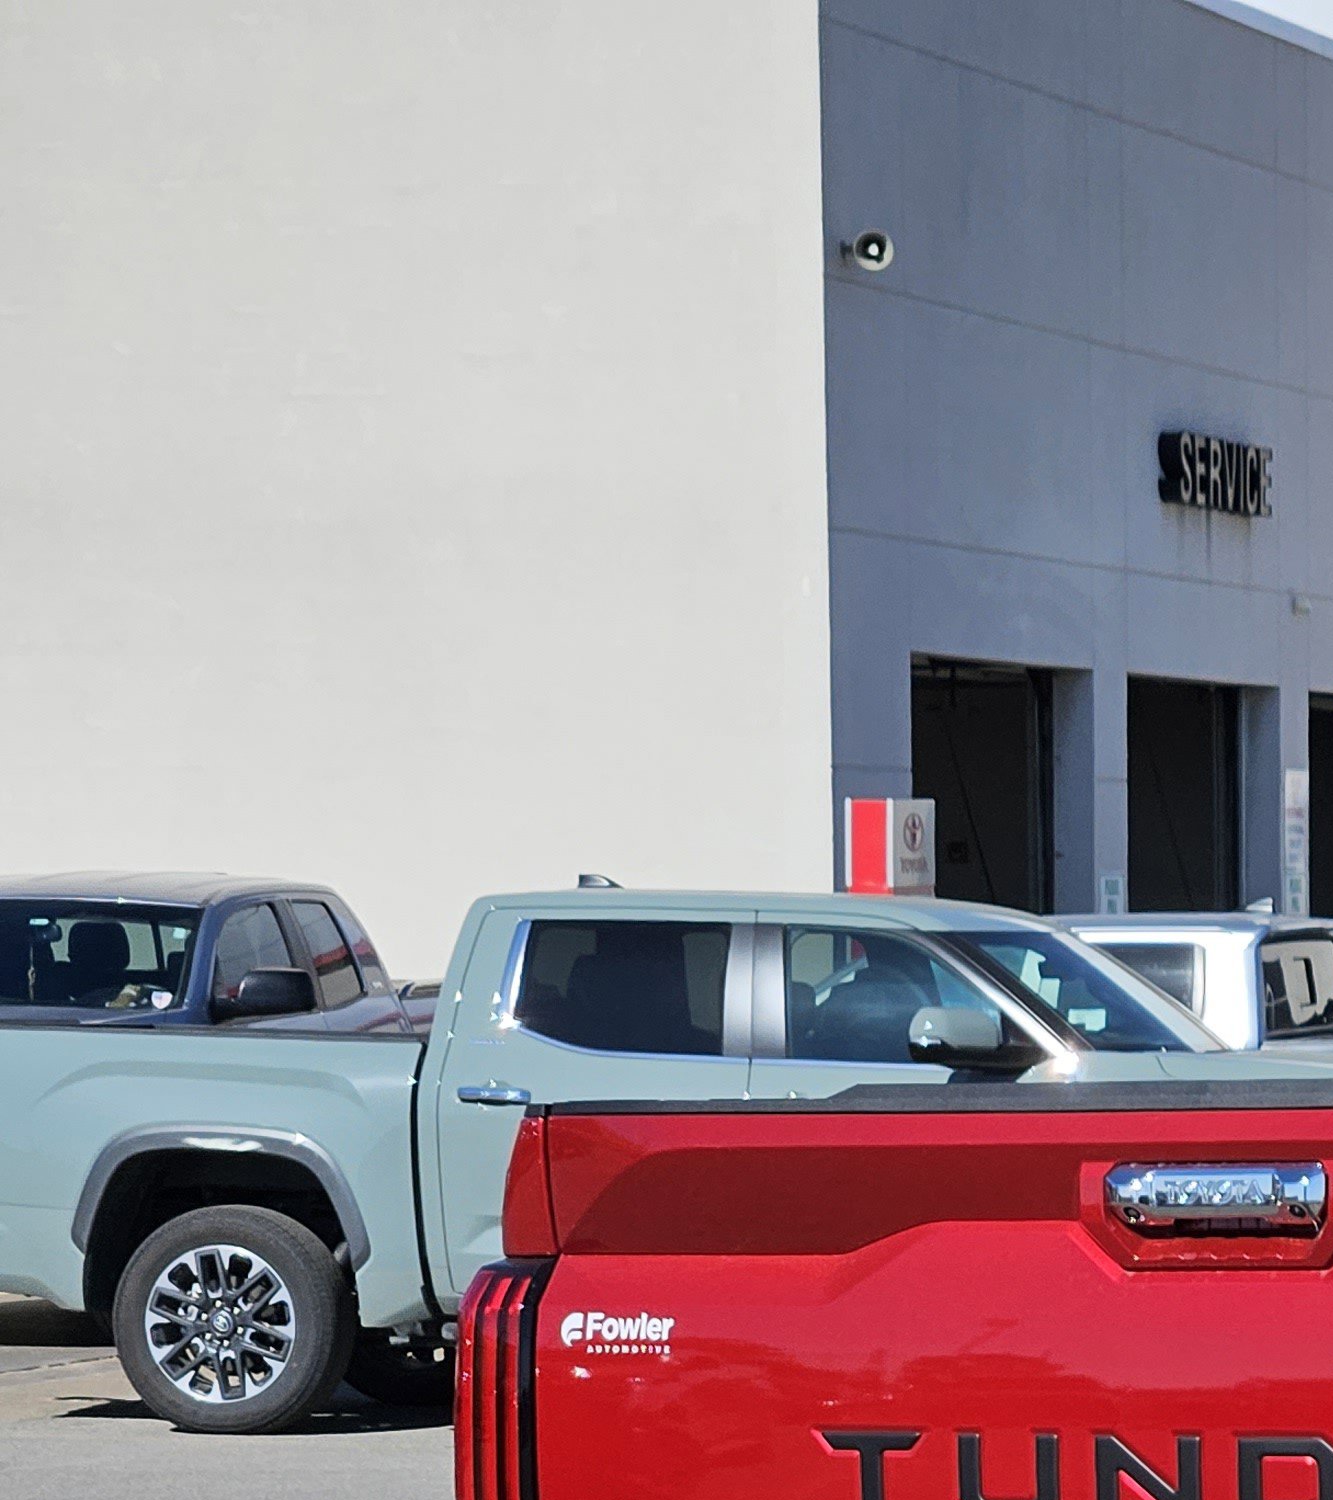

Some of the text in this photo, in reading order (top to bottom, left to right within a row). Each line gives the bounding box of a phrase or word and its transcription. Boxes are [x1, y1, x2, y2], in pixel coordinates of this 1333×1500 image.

[1177, 430, 1272, 518] SERVICE
[1164, 1180, 1268, 1204] TOYOTA
[585, 1311, 675, 1341] Fowler
[586, 1345, 671, 1354] AUTOMOTIVE
